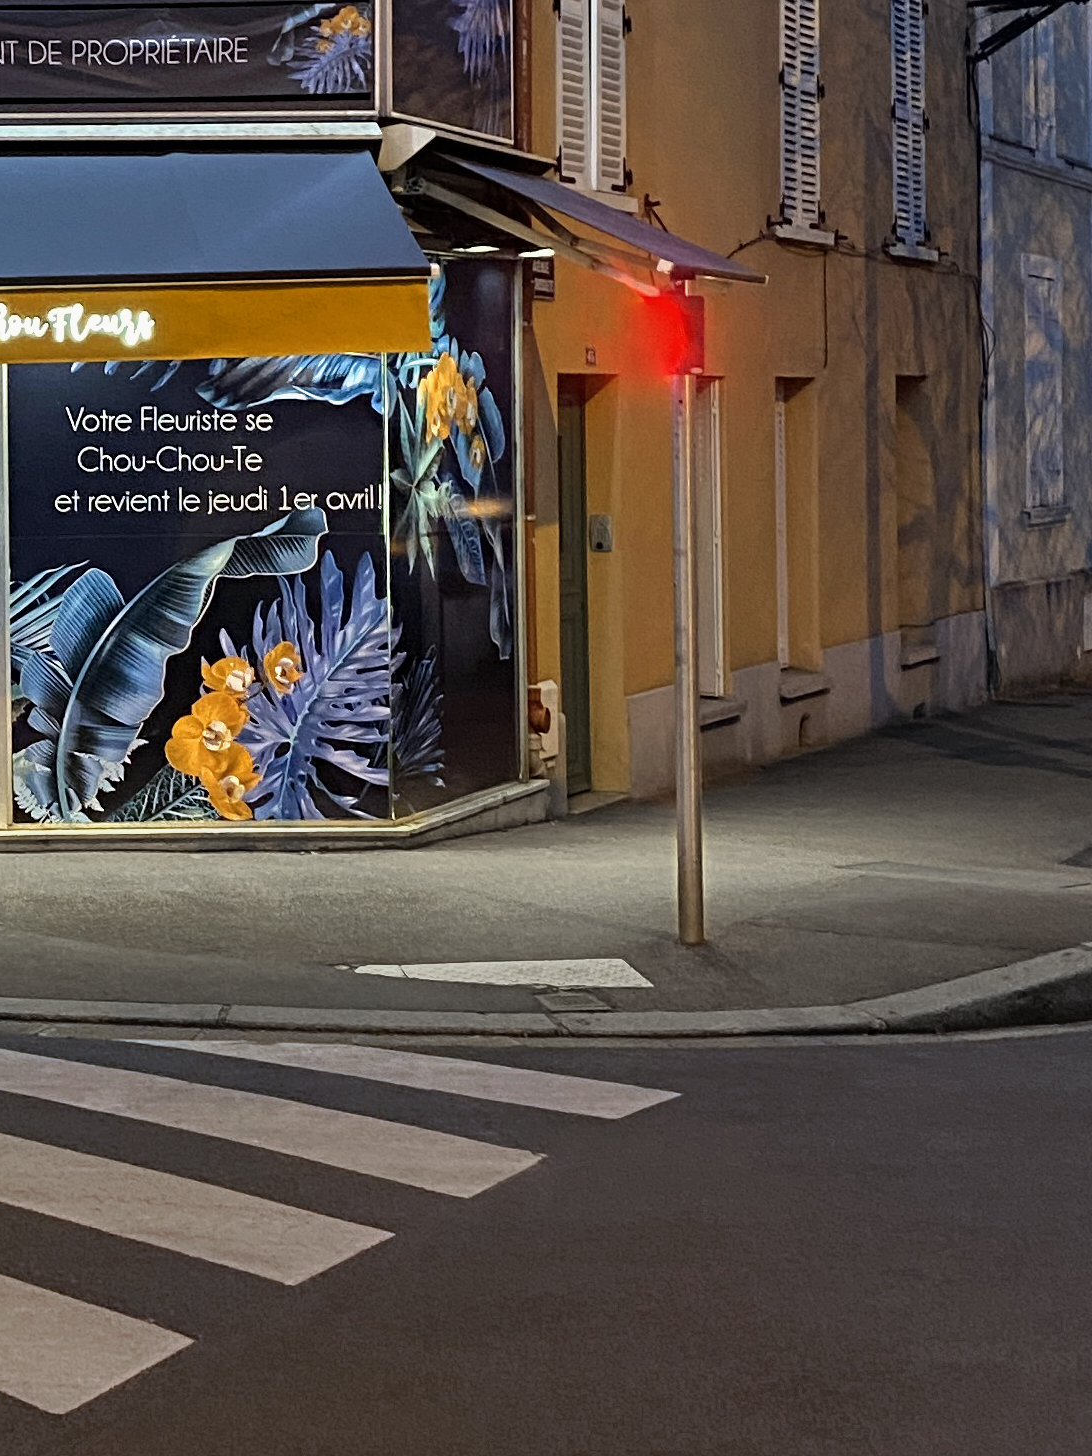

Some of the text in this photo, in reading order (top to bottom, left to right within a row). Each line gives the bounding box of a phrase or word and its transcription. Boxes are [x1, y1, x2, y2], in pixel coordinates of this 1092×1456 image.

[27, 40, 64, 66] DE
[70, 34, 249, 66] PROPRIÉTAIRE
[47, 301, 156, 347] Fleurs
[65, 406, 274, 432] Votre Fleuriste se
[76, 445, 263, 473] Chou-Chou-Te
[54, 490, 81, 513] et
[88, 490, 170, 513] revient
[178, 486, 201, 512] le
[206, 484, 269, 515] jeudi
[277, 485, 319, 512] 1er
